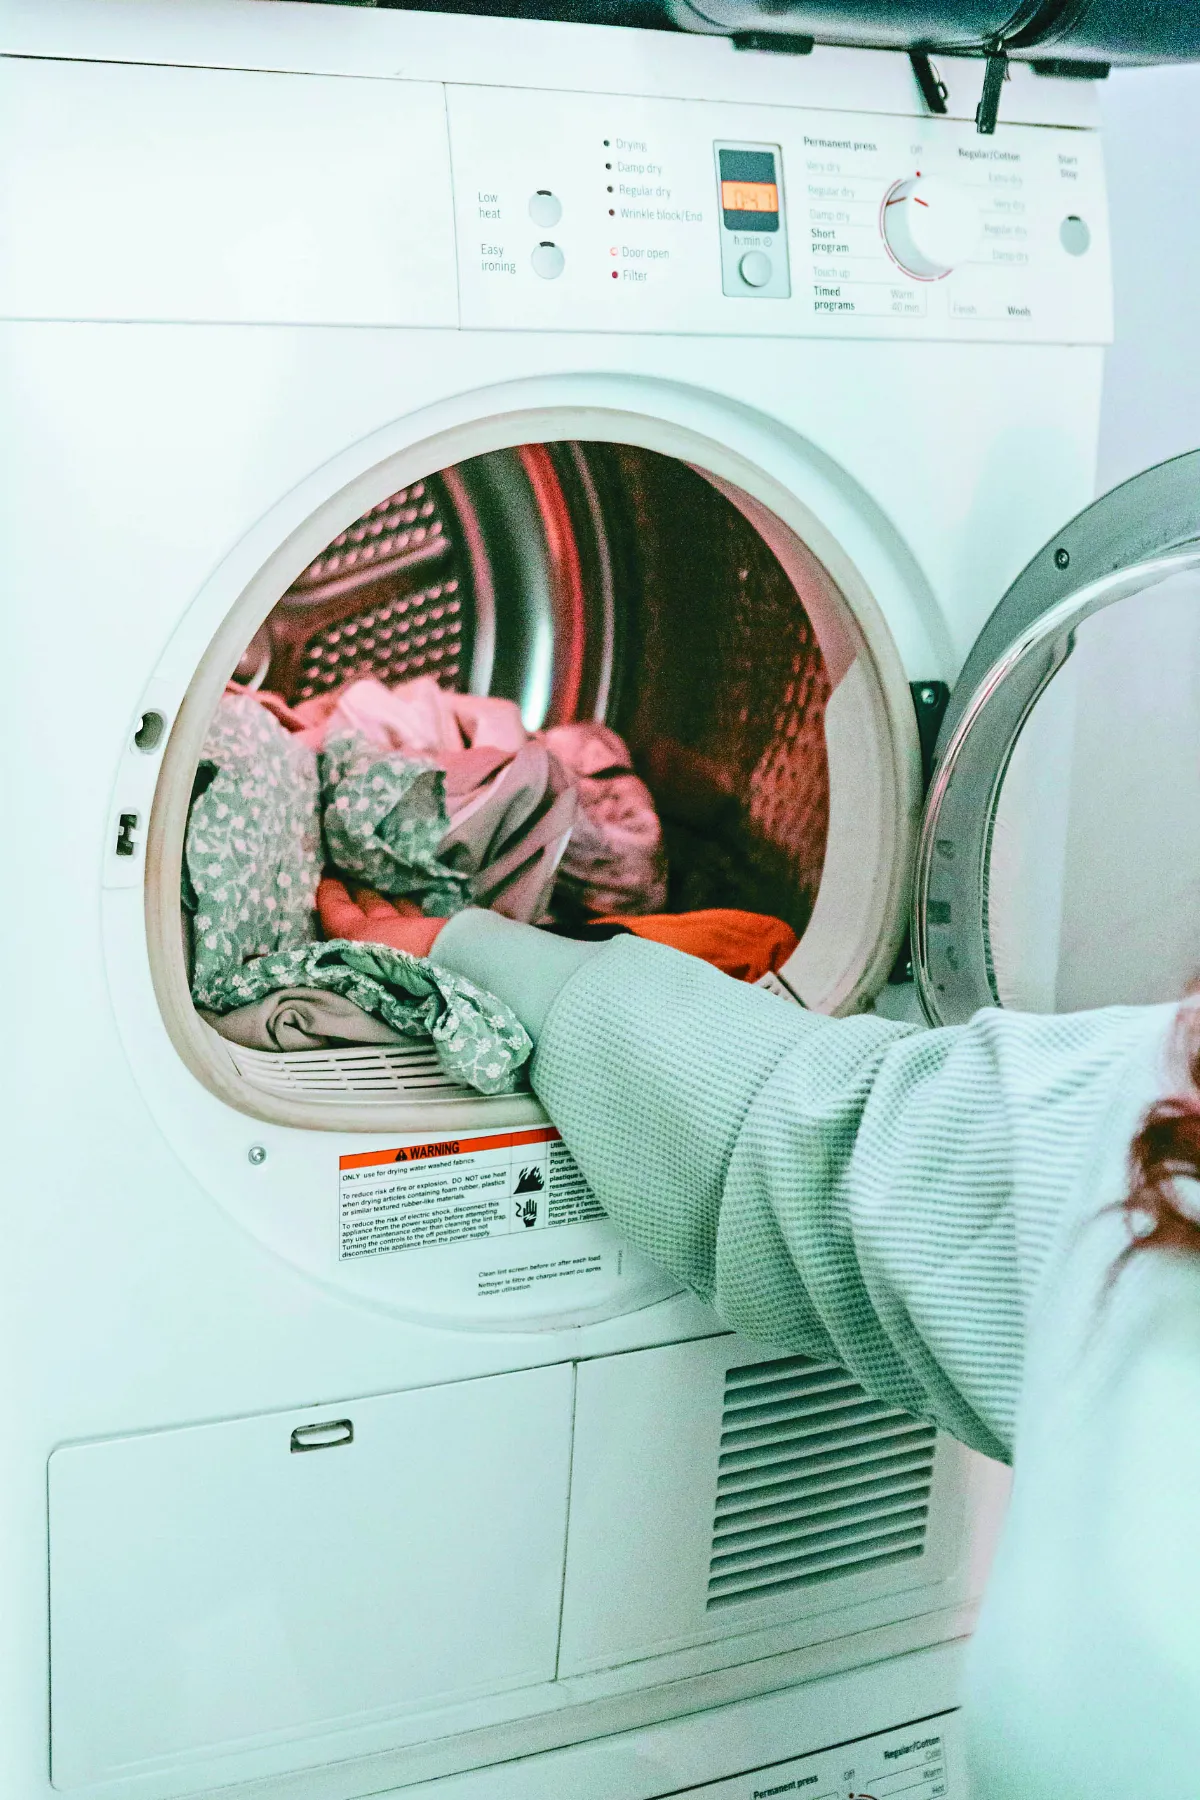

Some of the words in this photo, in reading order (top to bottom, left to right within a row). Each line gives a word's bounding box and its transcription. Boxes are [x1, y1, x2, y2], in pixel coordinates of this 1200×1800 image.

[616, 138, 646, 152] Drying
[804, 136, 852, 150] Permanent
[853, 140, 877, 152] press
[958, 148, 1020, 162] Regular/Cotton
[618, 162, 644, 174] Damp
[646, 163, 662, 175] dry
[478, 192, 498, 203] Low
[619, 184, 653, 197] Regular
[655, 185, 671, 199] dry
[479, 207, 501, 219] heat
[620, 208, 655, 220] Wrinkle
[656, 210, 702, 222] block/End
[811, 228, 835, 239] Short
[481, 244, 504, 257] Easy
[622, 247, 645, 258] Door
[647, 250, 669, 260] open
[812, 242, 849, 254] program
[481, 260, 516, 274] ironing
[813, 266, 838, 278] Touch
[623, 270, 647, 282] Filter
[814, 286, 840, 297] Timed
[814, 300, 855, 312] programs
[411, 1142, 460, 1159] WARNING
[754, 1781, 796, 1800] Permanent
[797, 1776, 818, 1788] press
